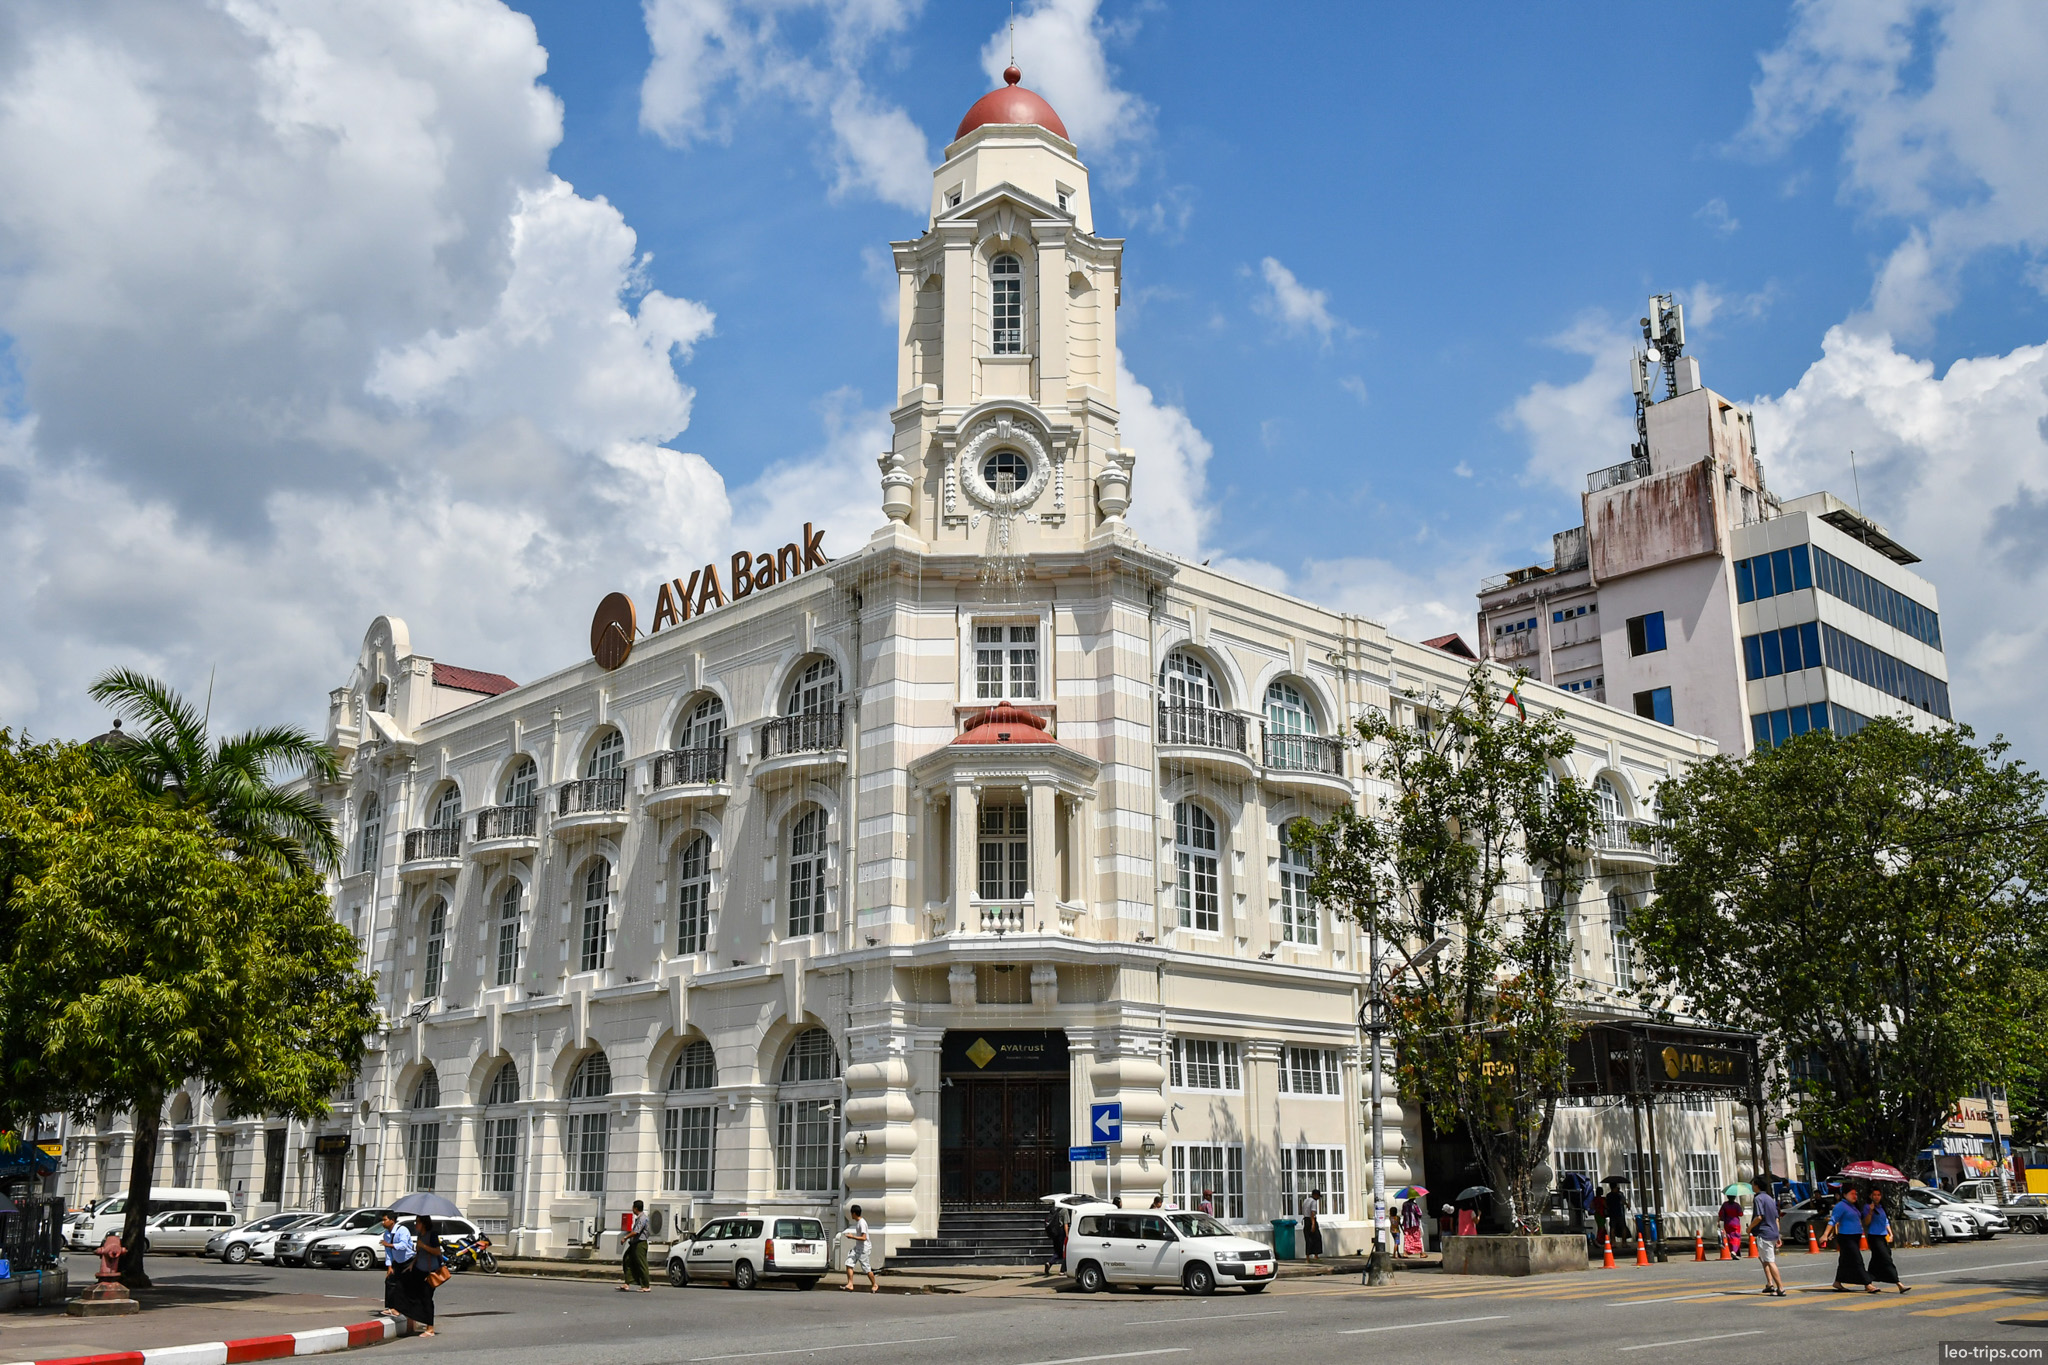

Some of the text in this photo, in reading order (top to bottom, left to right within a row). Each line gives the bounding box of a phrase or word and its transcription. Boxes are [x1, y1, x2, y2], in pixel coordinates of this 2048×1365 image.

[652, 522, 827, 633] AYA Bank
[1000, 1044, 1045, 1052] AYAtrust
[1681, 1053, 1734, 1075] AYA Bank
[0, 1164, 31, 1175] elenor
